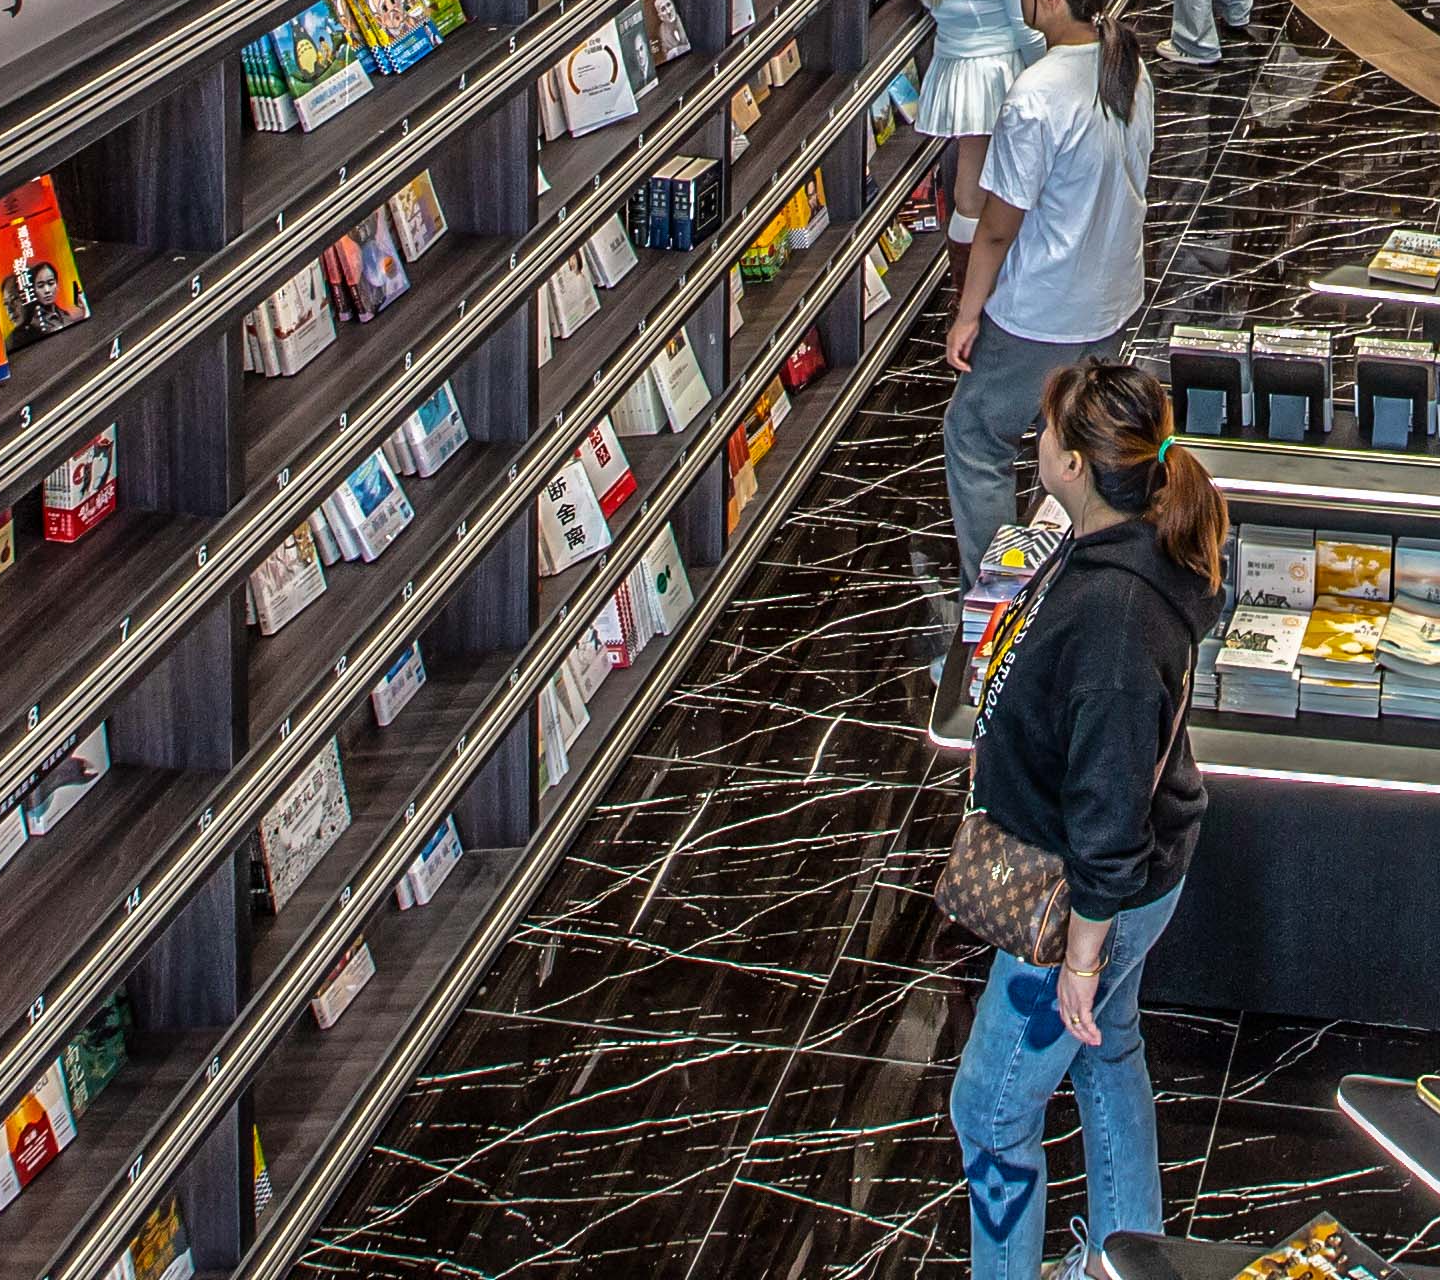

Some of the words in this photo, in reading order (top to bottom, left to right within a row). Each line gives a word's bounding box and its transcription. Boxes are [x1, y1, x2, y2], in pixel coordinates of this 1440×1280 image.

[13, 257, 38, 306] 救世主
[190, 276, 202, 299] 5
[108, 337, 121, 360] 4
[20, 405, 31, 428] 3
[196, 544, 209, 567] 6
[119, 616, 131, 643] 7
[25, 703, 40, 730] 8
[197, 808, 213, 831] 15
[122, 886, 142, 915] 14
[26, 995, 46, 1026] 13
[126, 1155, 144, 1184] 17
